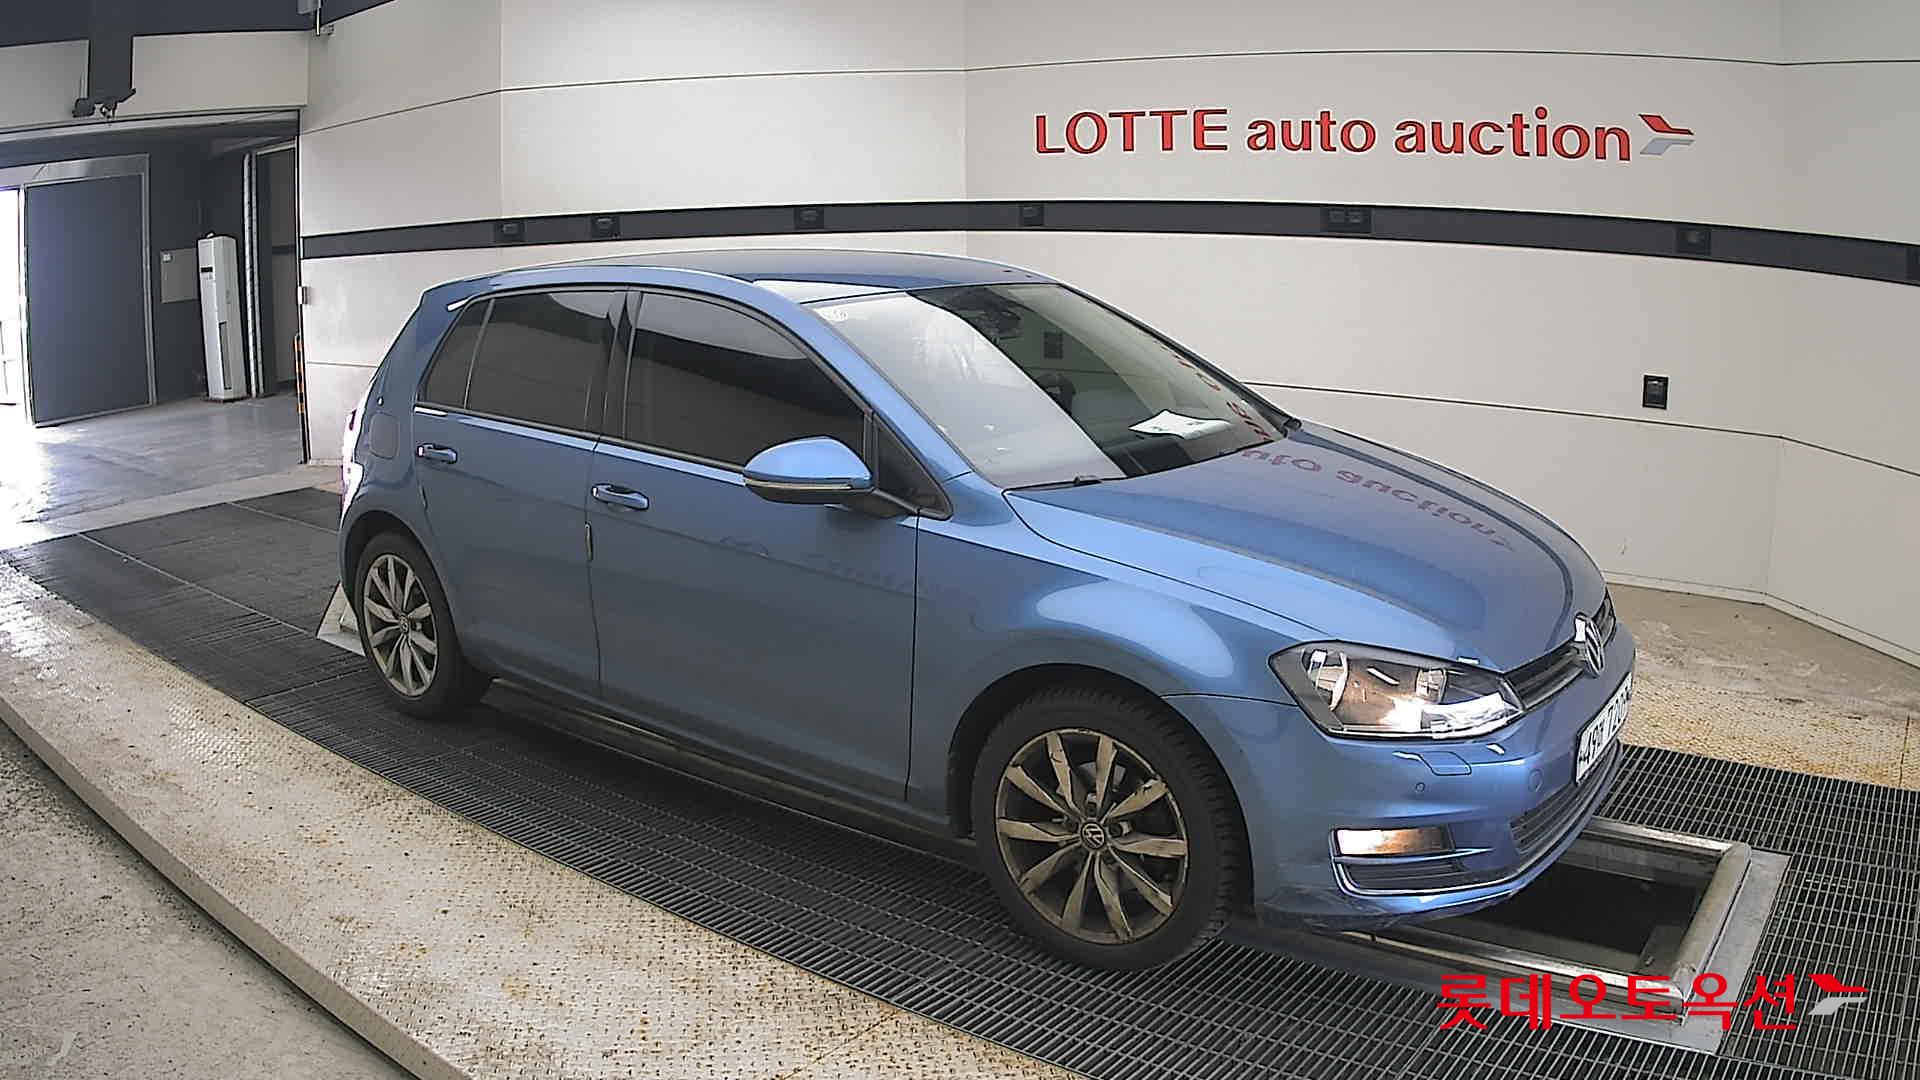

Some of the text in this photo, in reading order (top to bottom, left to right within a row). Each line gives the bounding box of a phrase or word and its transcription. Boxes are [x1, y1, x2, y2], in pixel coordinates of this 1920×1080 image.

[1035, 106, 1632, 162] LOTTE auto auction
